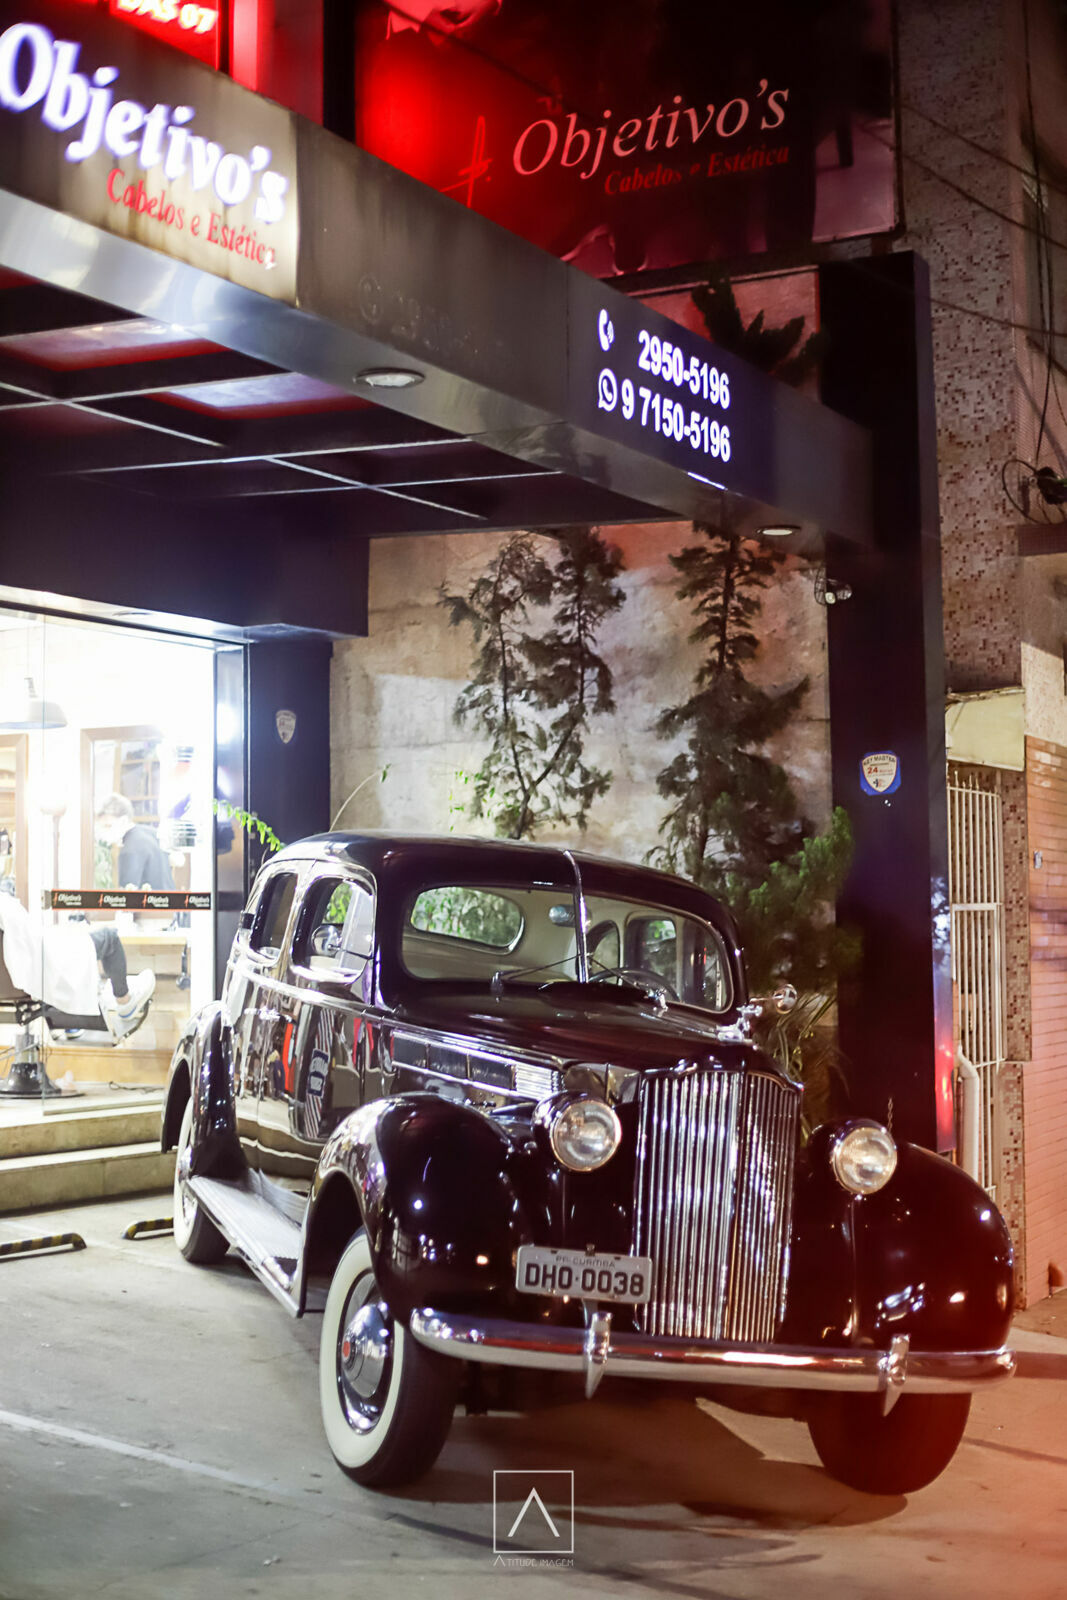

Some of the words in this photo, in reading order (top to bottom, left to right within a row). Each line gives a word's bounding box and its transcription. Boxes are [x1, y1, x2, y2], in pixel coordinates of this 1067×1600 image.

[178, 3, 218, 34] 07
[0, 22, 289, 223] Objetivo's
[513, 78, 789, 179] Objetivo's
[604, 163, 682, 195] Cabelos
[707, 145, 789, 177] Estética
[106, 168, 184, 230] Cabelos
[190, 216, 201, 236] e
[206, 211, 276, 264] Estética
[638, 329, 730, 409] 2950-5196
[621, 378, 635, 420] 9
[638, 386, 731, 462] 7150-5196
